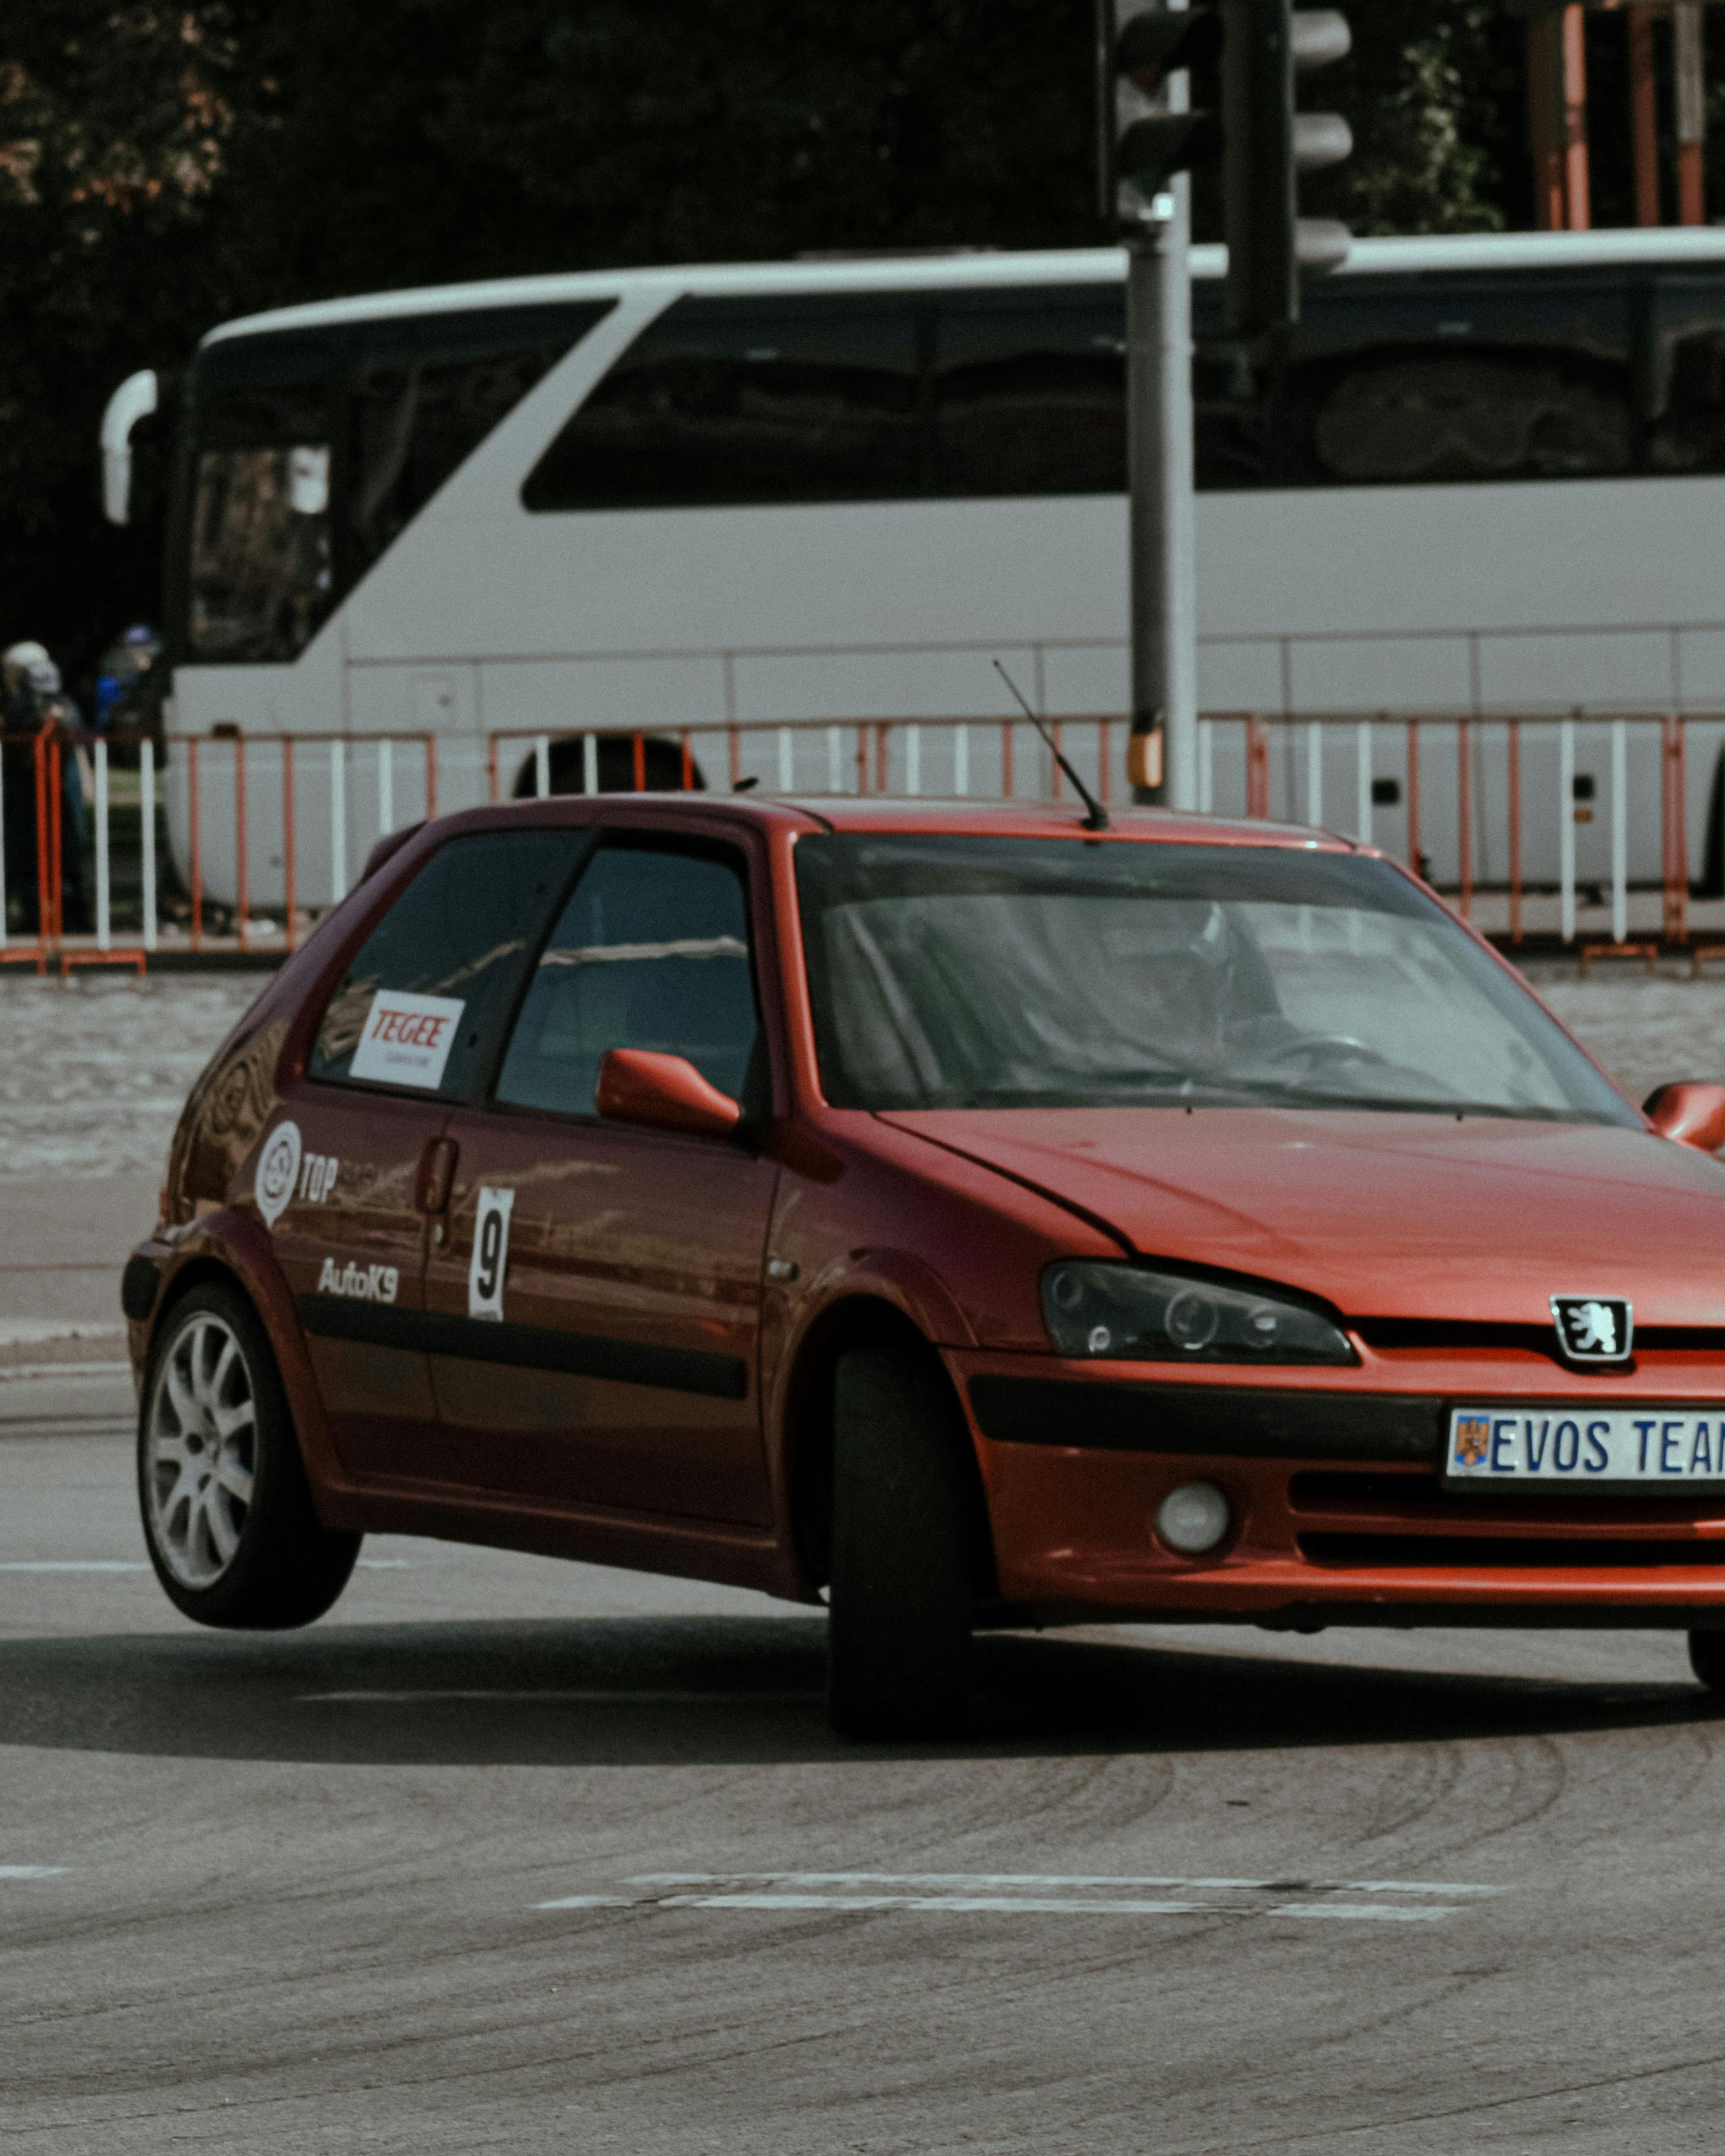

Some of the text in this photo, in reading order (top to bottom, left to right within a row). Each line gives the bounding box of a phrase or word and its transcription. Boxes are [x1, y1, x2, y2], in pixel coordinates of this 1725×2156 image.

[371, 1009, 450, 1048] TEGEE
[299, 1153, 339, 1203] TOP
[478, 1209, 502, 1300] 9
[318, 1257, 398, 1303] AutoK9
[1491, 1420, 1610, 1472] EVOS
